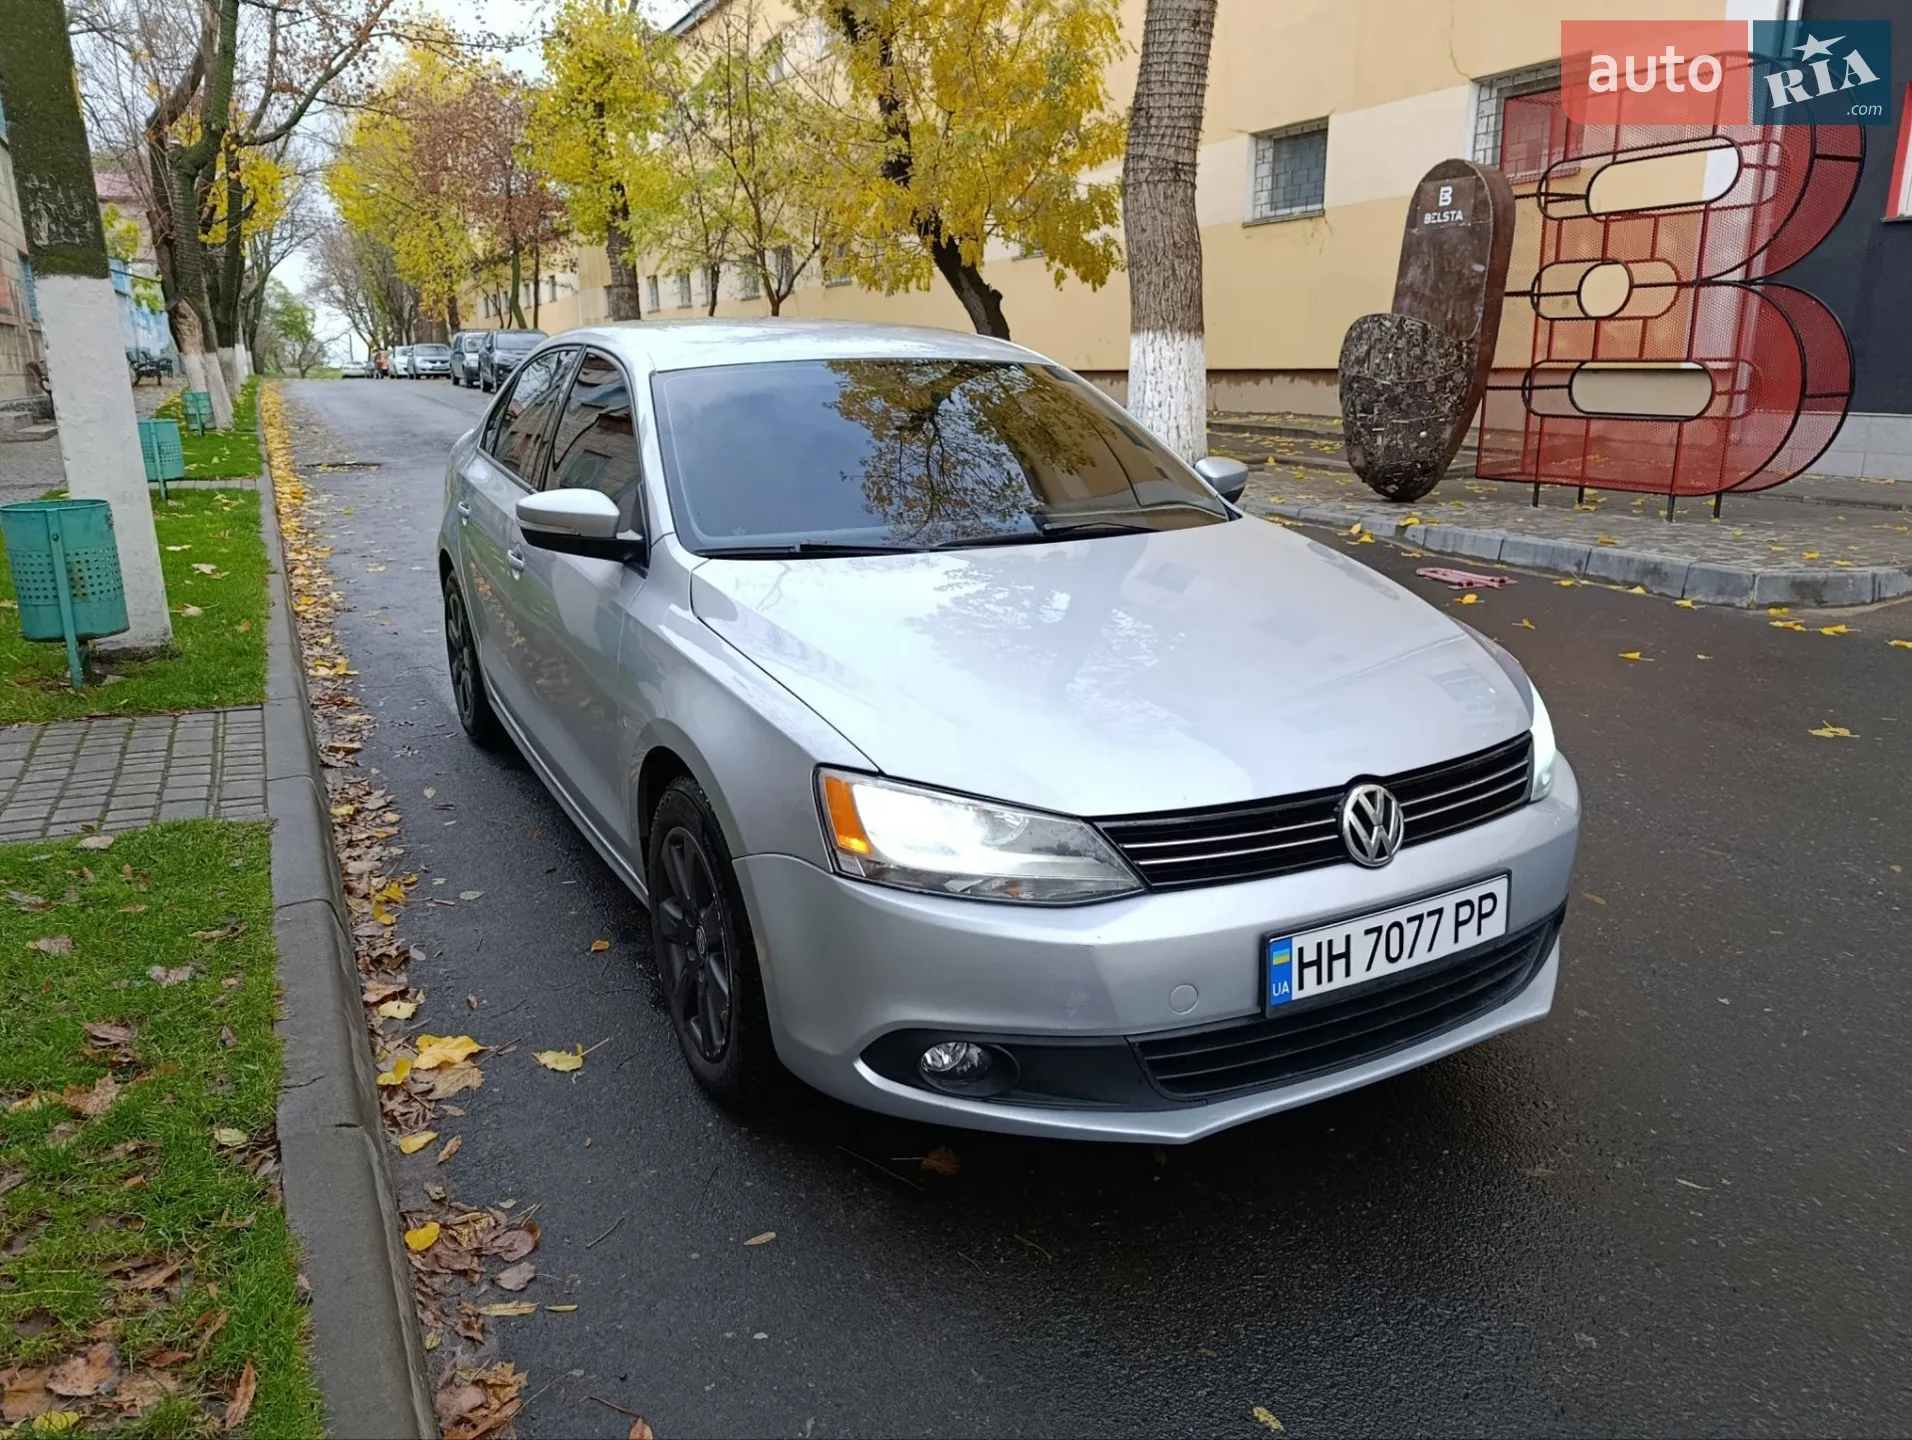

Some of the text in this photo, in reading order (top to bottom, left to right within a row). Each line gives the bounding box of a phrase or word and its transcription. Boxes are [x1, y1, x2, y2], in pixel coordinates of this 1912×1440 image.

[1423, 209, 1464, 225] BELSTA
[1297, 891, 1498, 991] HH 7077 PP
[1272, 980, 1290, 997] UA
